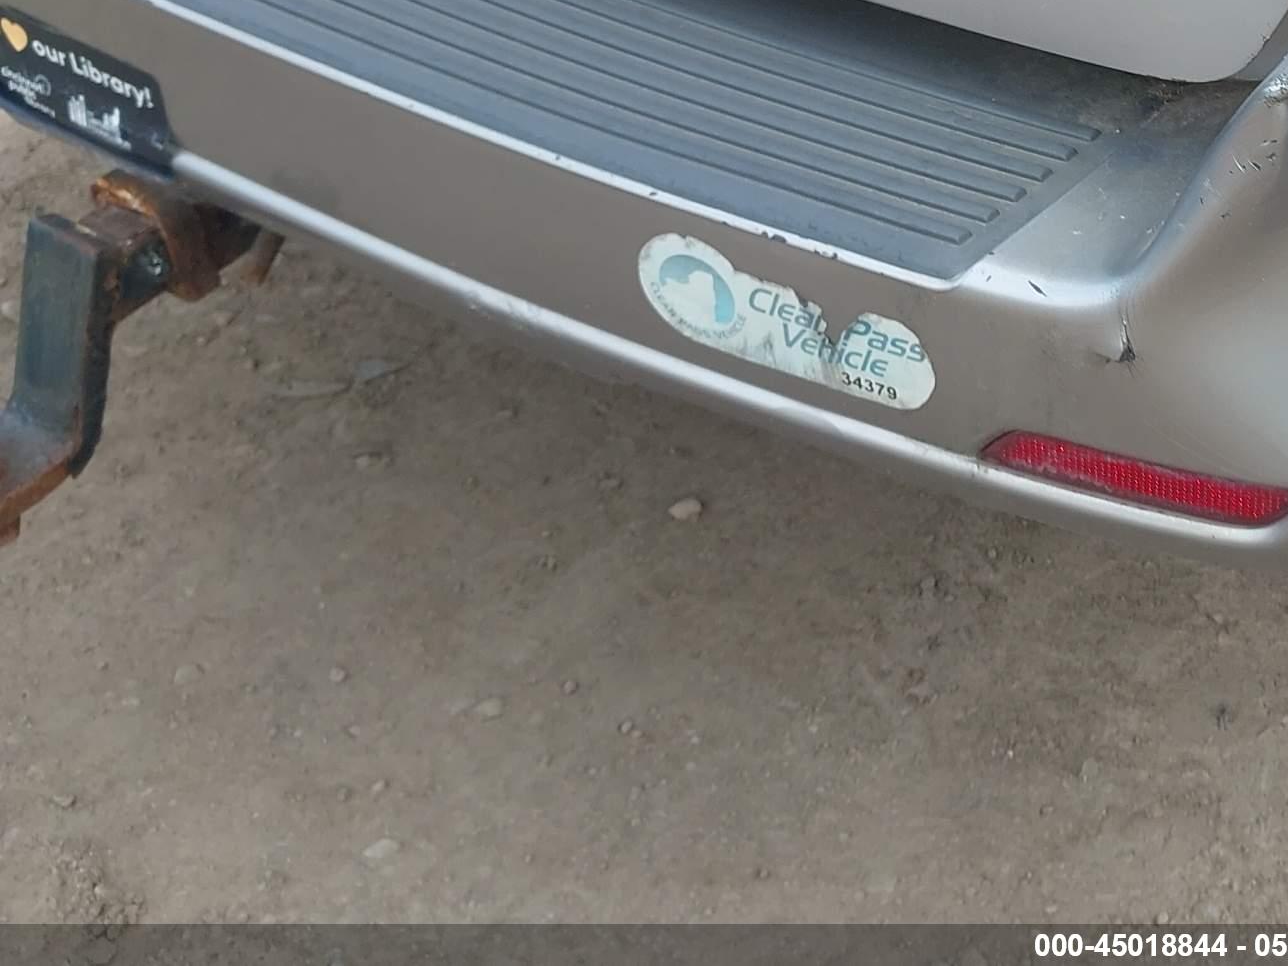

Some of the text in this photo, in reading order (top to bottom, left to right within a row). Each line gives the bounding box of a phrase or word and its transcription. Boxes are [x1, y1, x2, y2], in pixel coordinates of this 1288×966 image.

[32, 40, 66, 66] our
[68, 52, 154, 109] Library!
[782, 322, 888, 377] Vehicle
[841, 372, 897, 400] 34379
